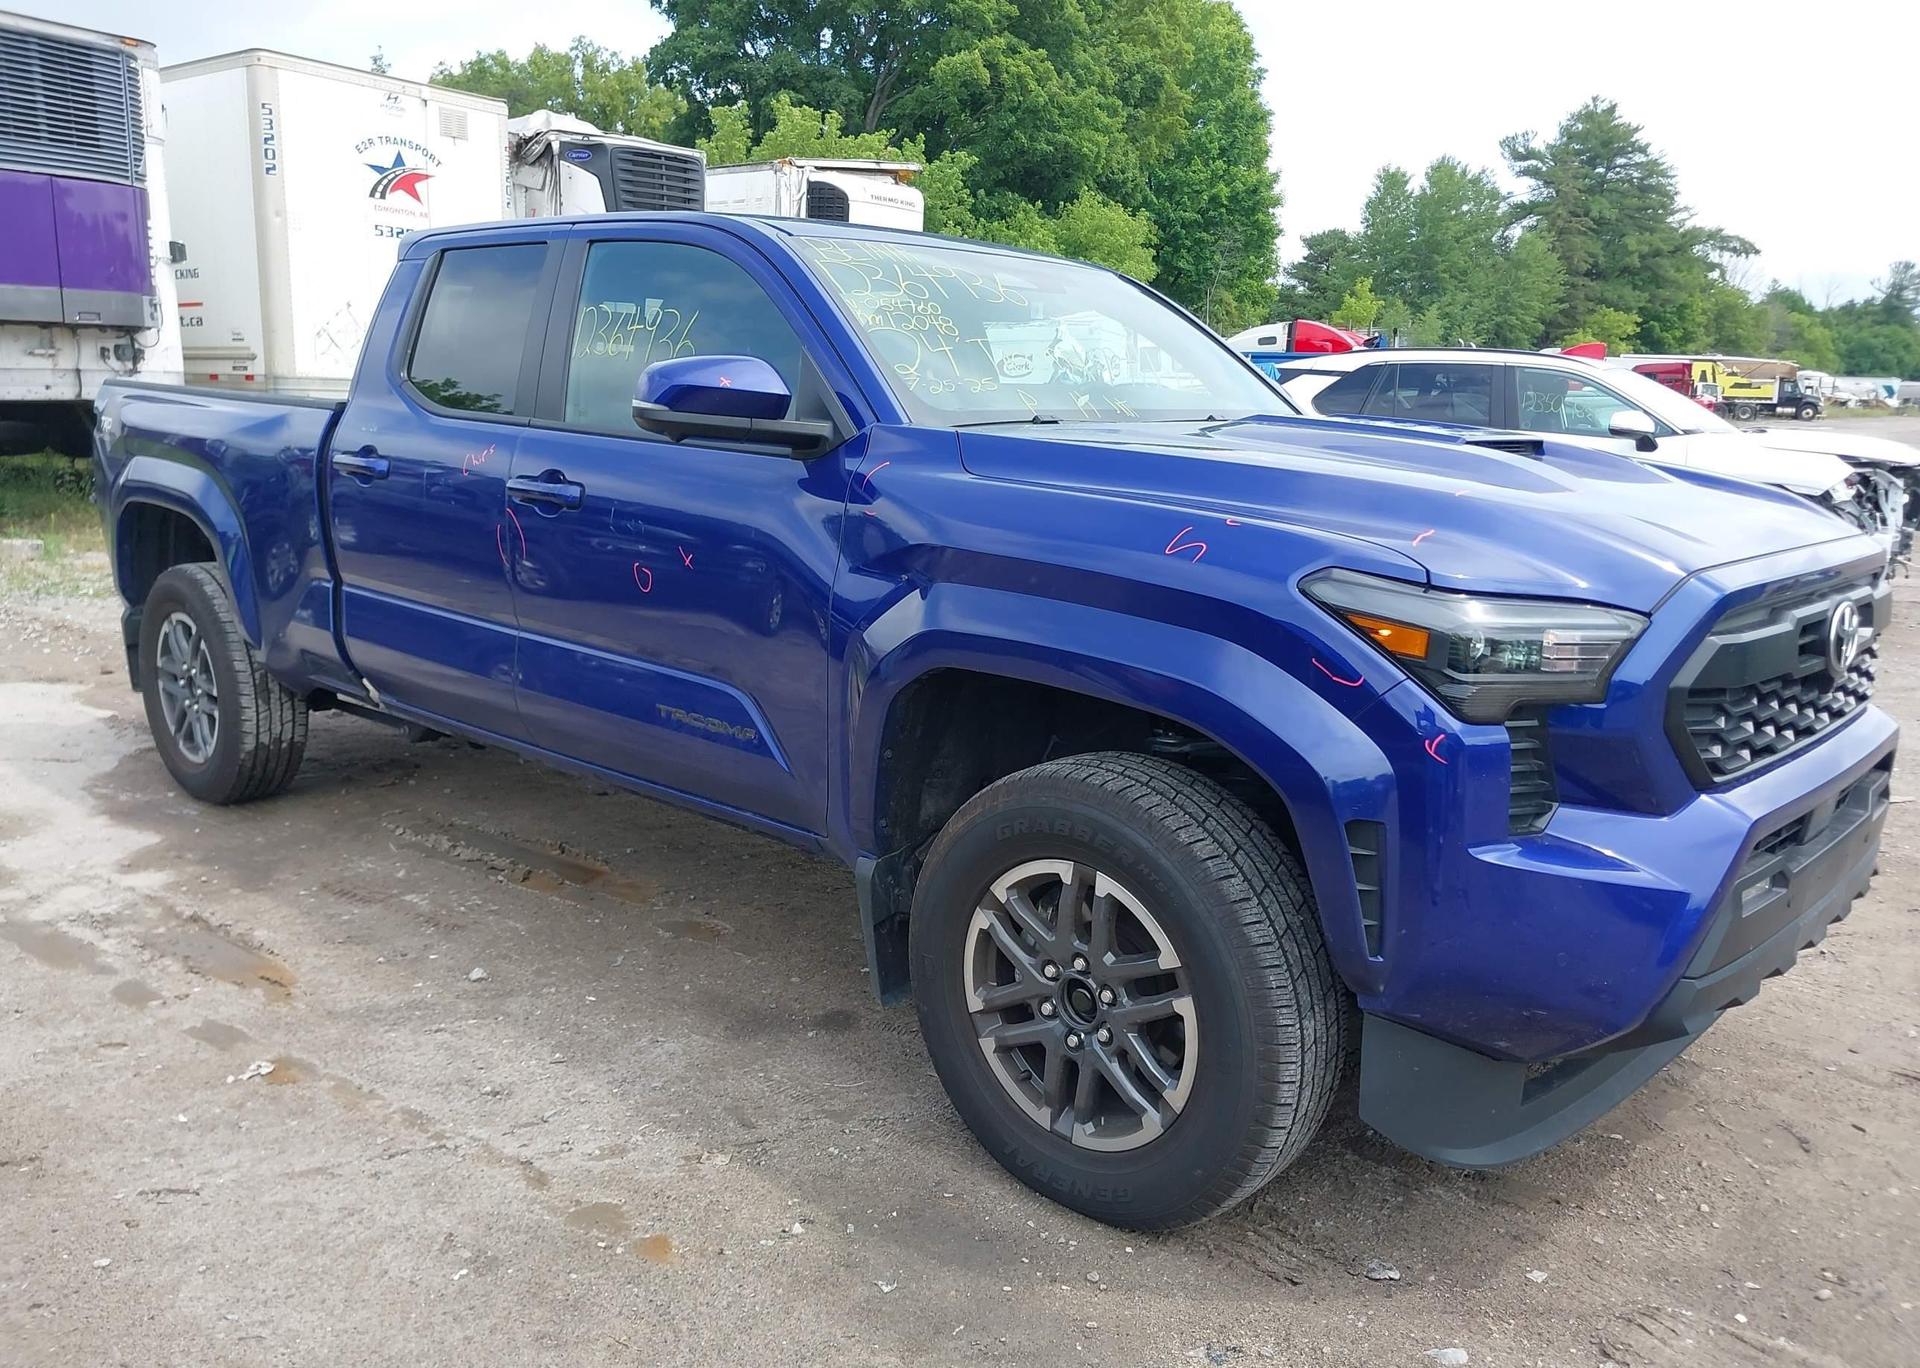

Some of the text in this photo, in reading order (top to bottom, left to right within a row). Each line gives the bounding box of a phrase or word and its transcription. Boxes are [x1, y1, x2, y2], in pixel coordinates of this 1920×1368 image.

[261, 102, 278, 176] 53202
[355, 136, 442, 168] E2R TRANSPORT
[871, 194, 916, 208] THERMO KING
[374, 224, 415, 239] 532
[996, 814, 1136, 864] GRABBER
